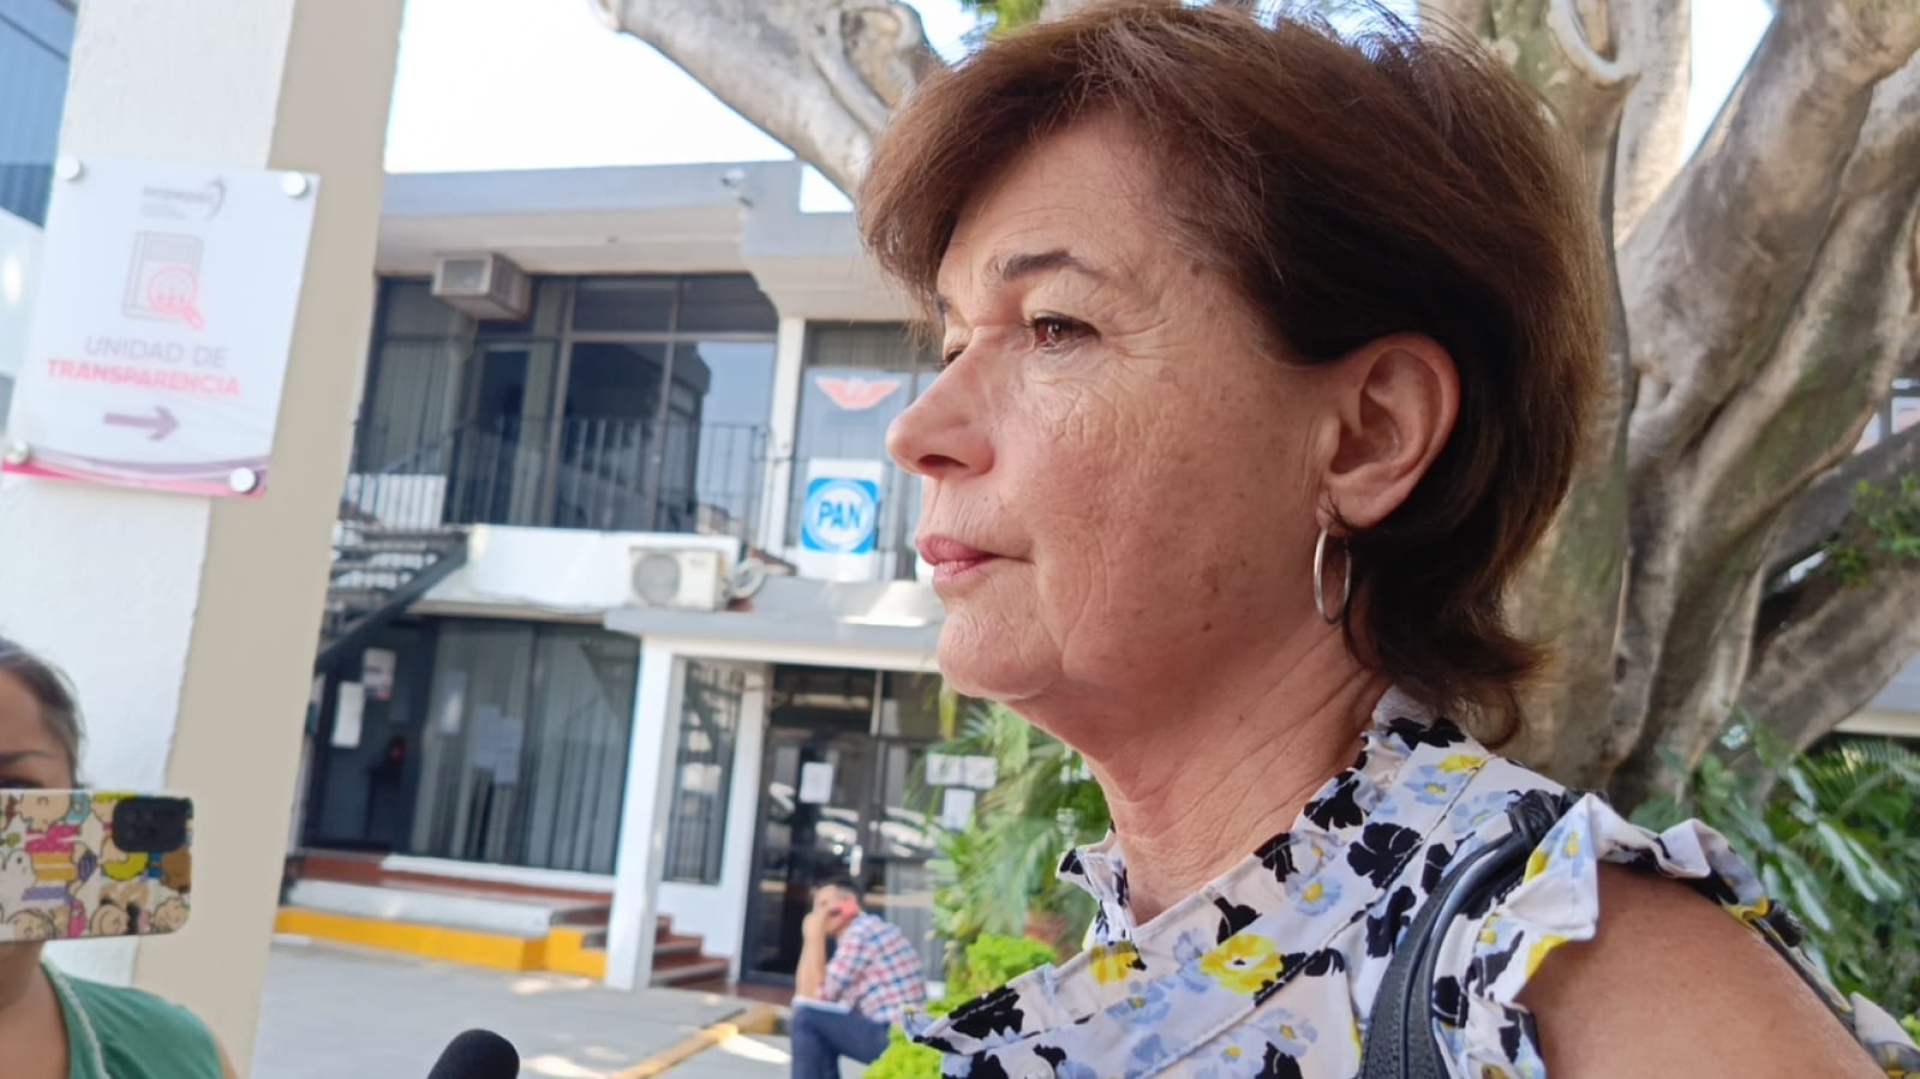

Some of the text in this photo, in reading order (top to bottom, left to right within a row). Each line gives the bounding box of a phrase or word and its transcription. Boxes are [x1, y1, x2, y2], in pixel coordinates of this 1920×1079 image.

[85, 335, 229, 368] UNIDAD DE
[47, 358, 240, 395] TRANSPARENCIA
[817, 500, 862, 529] PAN
